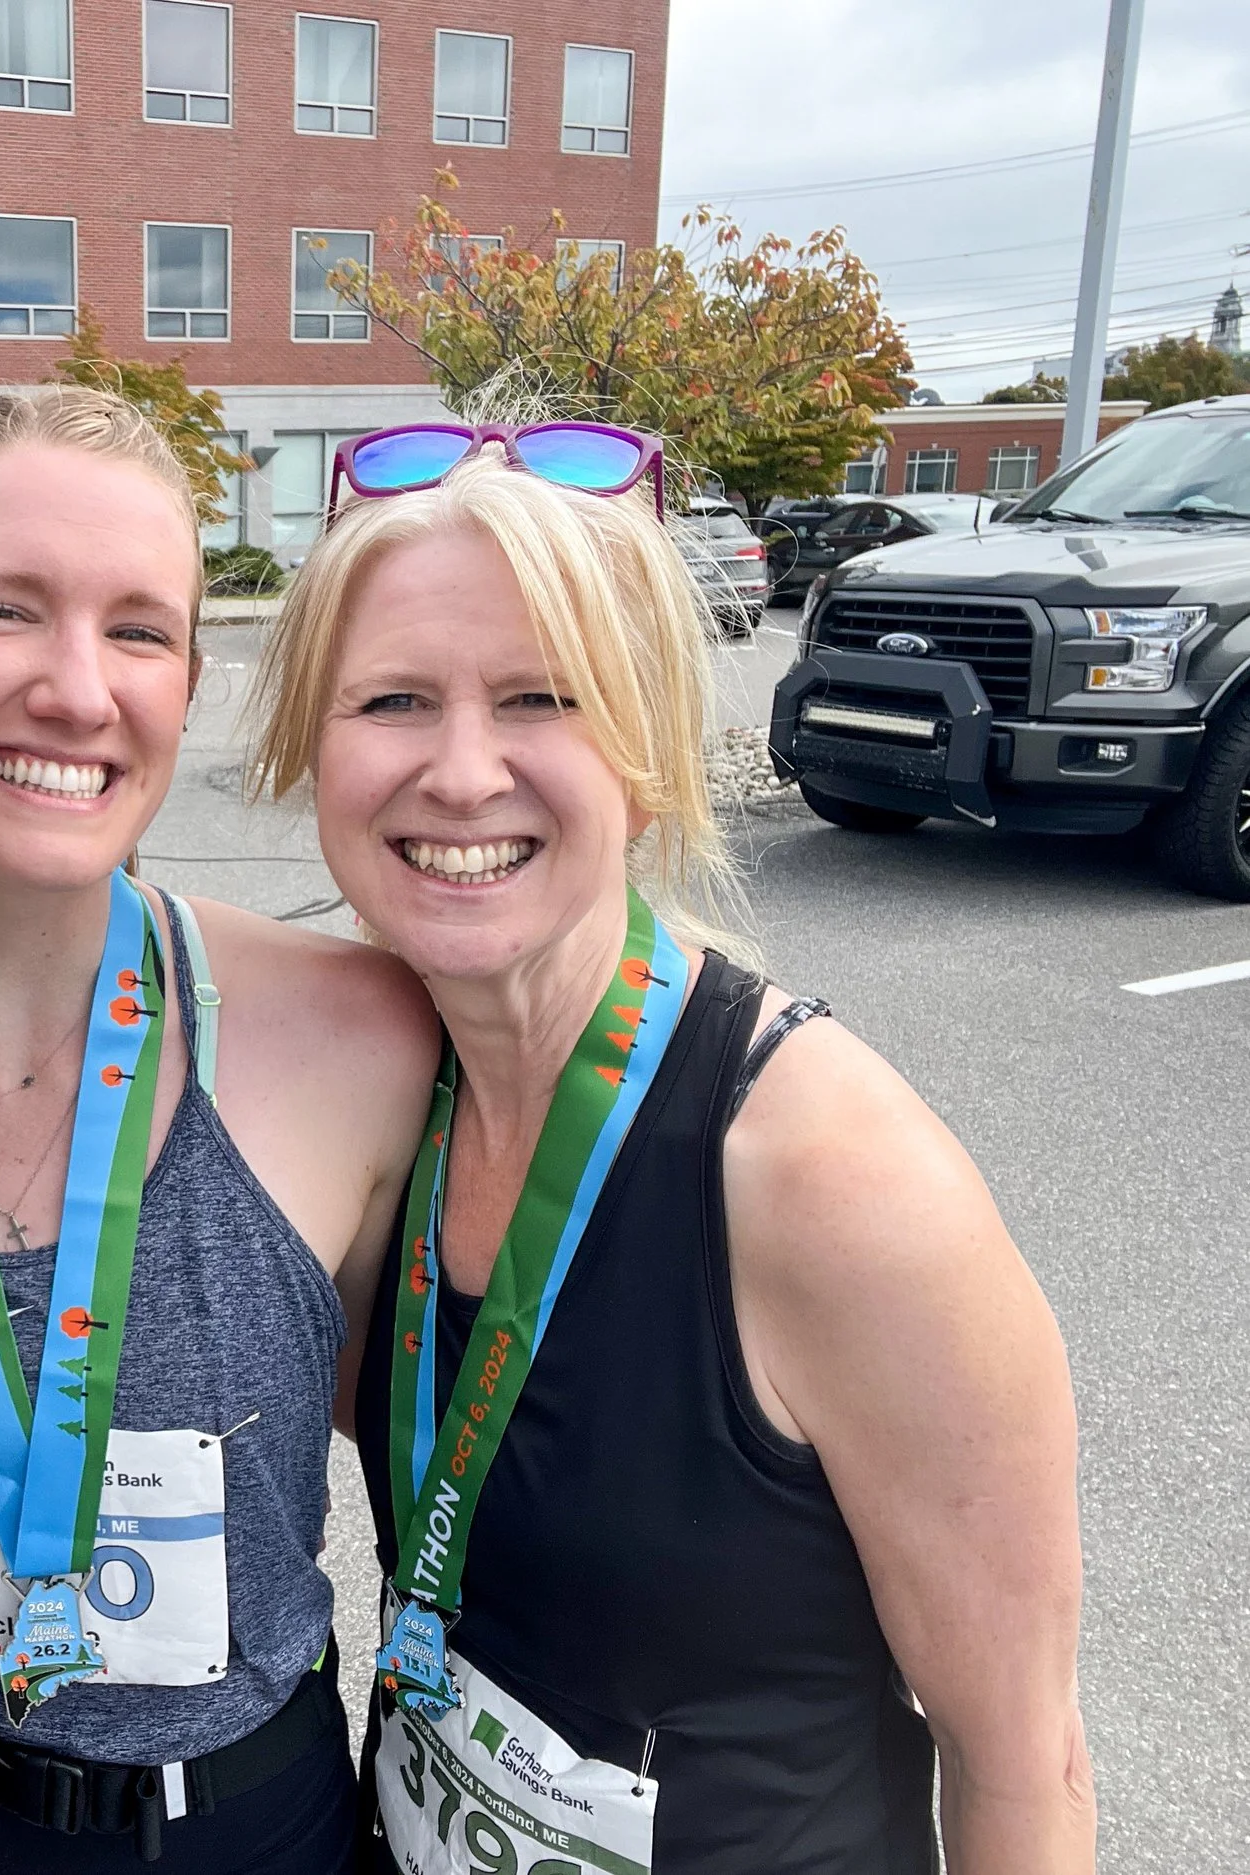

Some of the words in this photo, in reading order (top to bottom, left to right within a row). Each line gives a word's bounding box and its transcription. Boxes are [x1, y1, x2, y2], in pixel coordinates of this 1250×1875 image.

[479, 1329, 513, 1396] 2024
[469, 1402, 491, 1422] 6,
[451, 1421, 478, 1477] OCT
[117, 1473, 164, 1487] Bank
[111, 1520, 140, 1534] ME
[28, 1601, 65, 1614] 2024
[30, 1622, 70, 1637] Maine
[404, 1616, 433, 1637] 2024
[33, 1643, 71, 1657] 26.2
[507, 1737, 554, 1784] Gorham
[408, 1709, 441, 1752] October
[450, 1758, 475, 1791] 2024
[477, 1783, 539, 1837] Portland,
[543, 1827, 570, 1849] ME
[498, 1750, 548, 1797] Savings
[551, 1788, 594, 1816] Bank
[399, 1722, 582, 1875] 379
